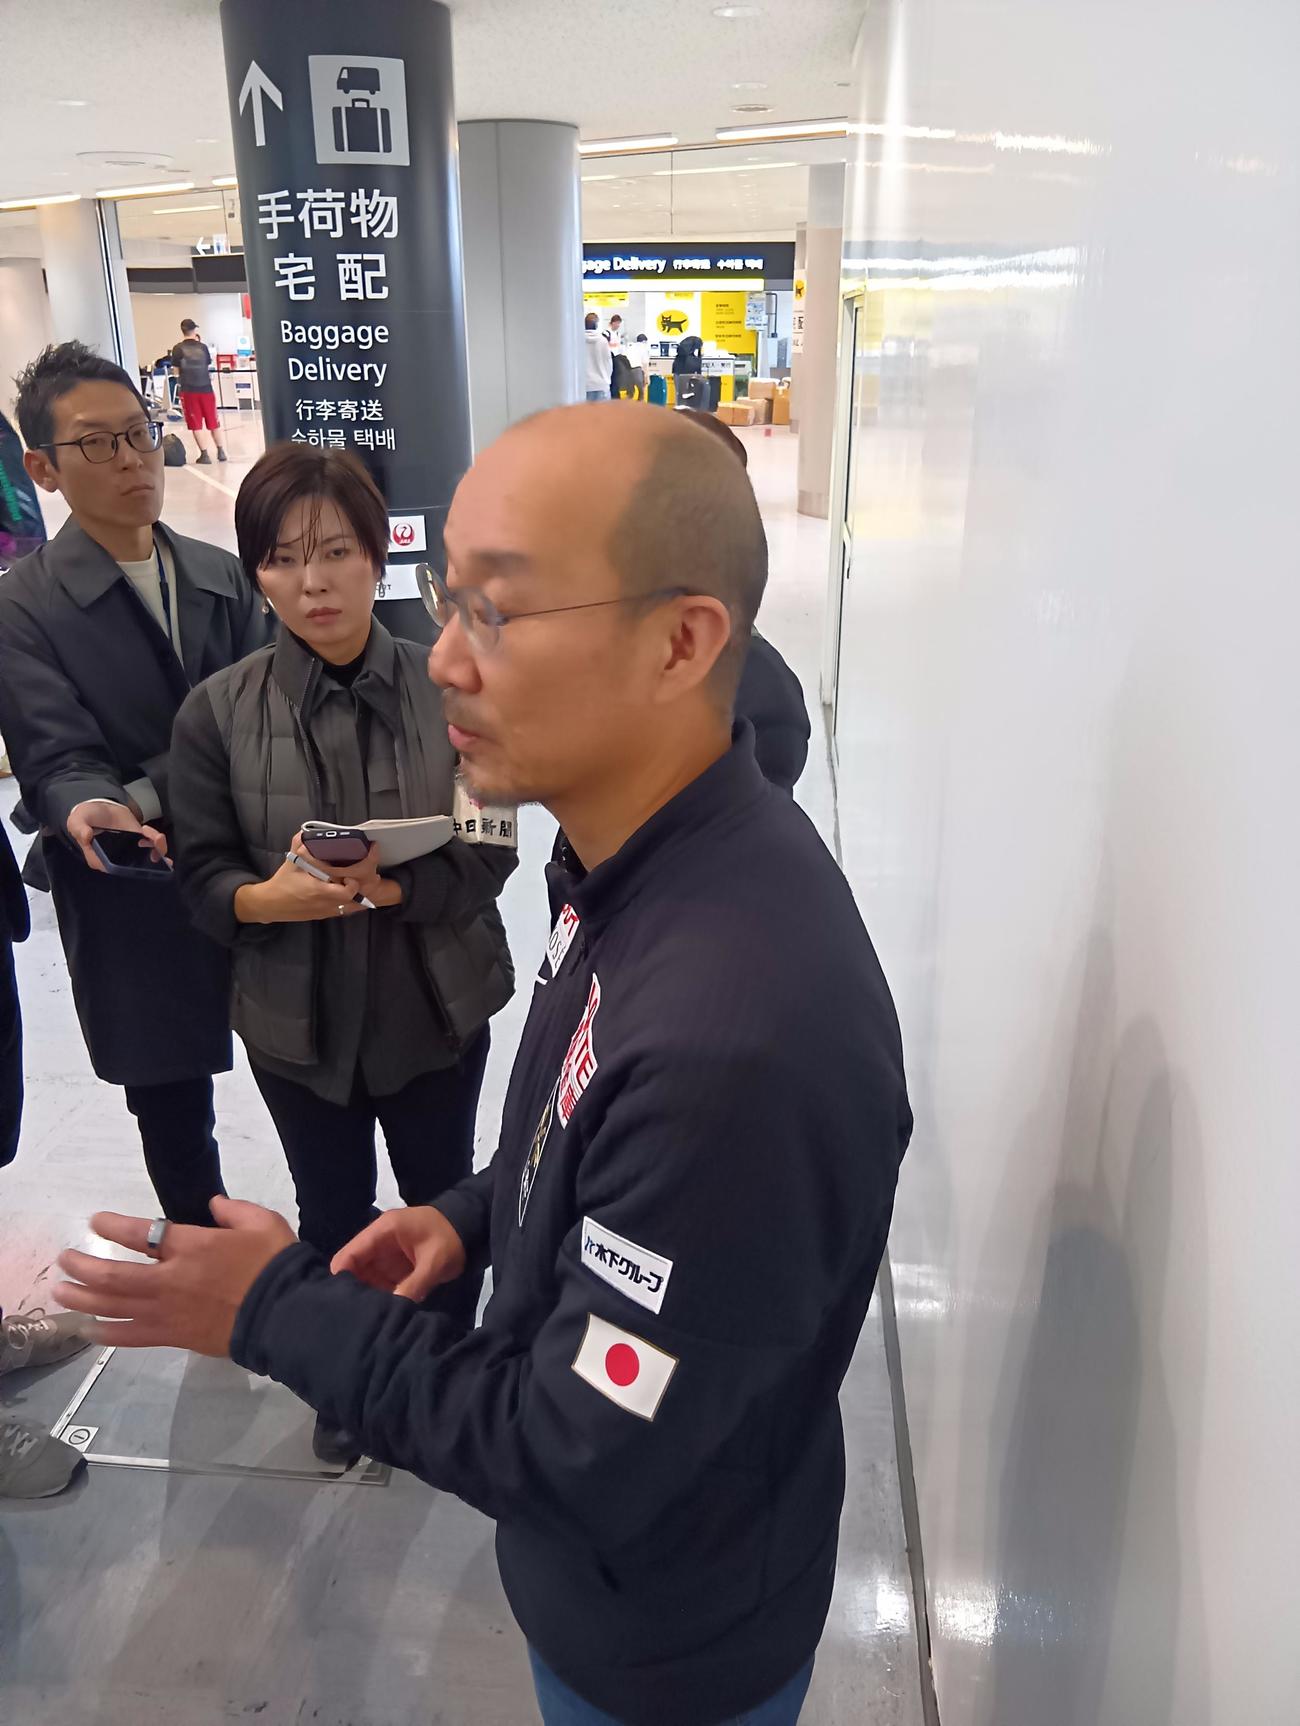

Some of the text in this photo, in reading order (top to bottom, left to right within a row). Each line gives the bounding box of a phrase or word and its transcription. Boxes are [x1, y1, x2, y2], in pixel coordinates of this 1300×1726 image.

[257, 188, 399, 239] 手荷物
[613, 256, 667, 274] Delivery
[280, 319, 389, 350] Baggage
[288, 356, 387, 387] Delivery
[295, 398, 385, 421] 行李寄送
[353, 428, 396, 451] 택배
[594, 1242, 665, 1293] 木下グループ
